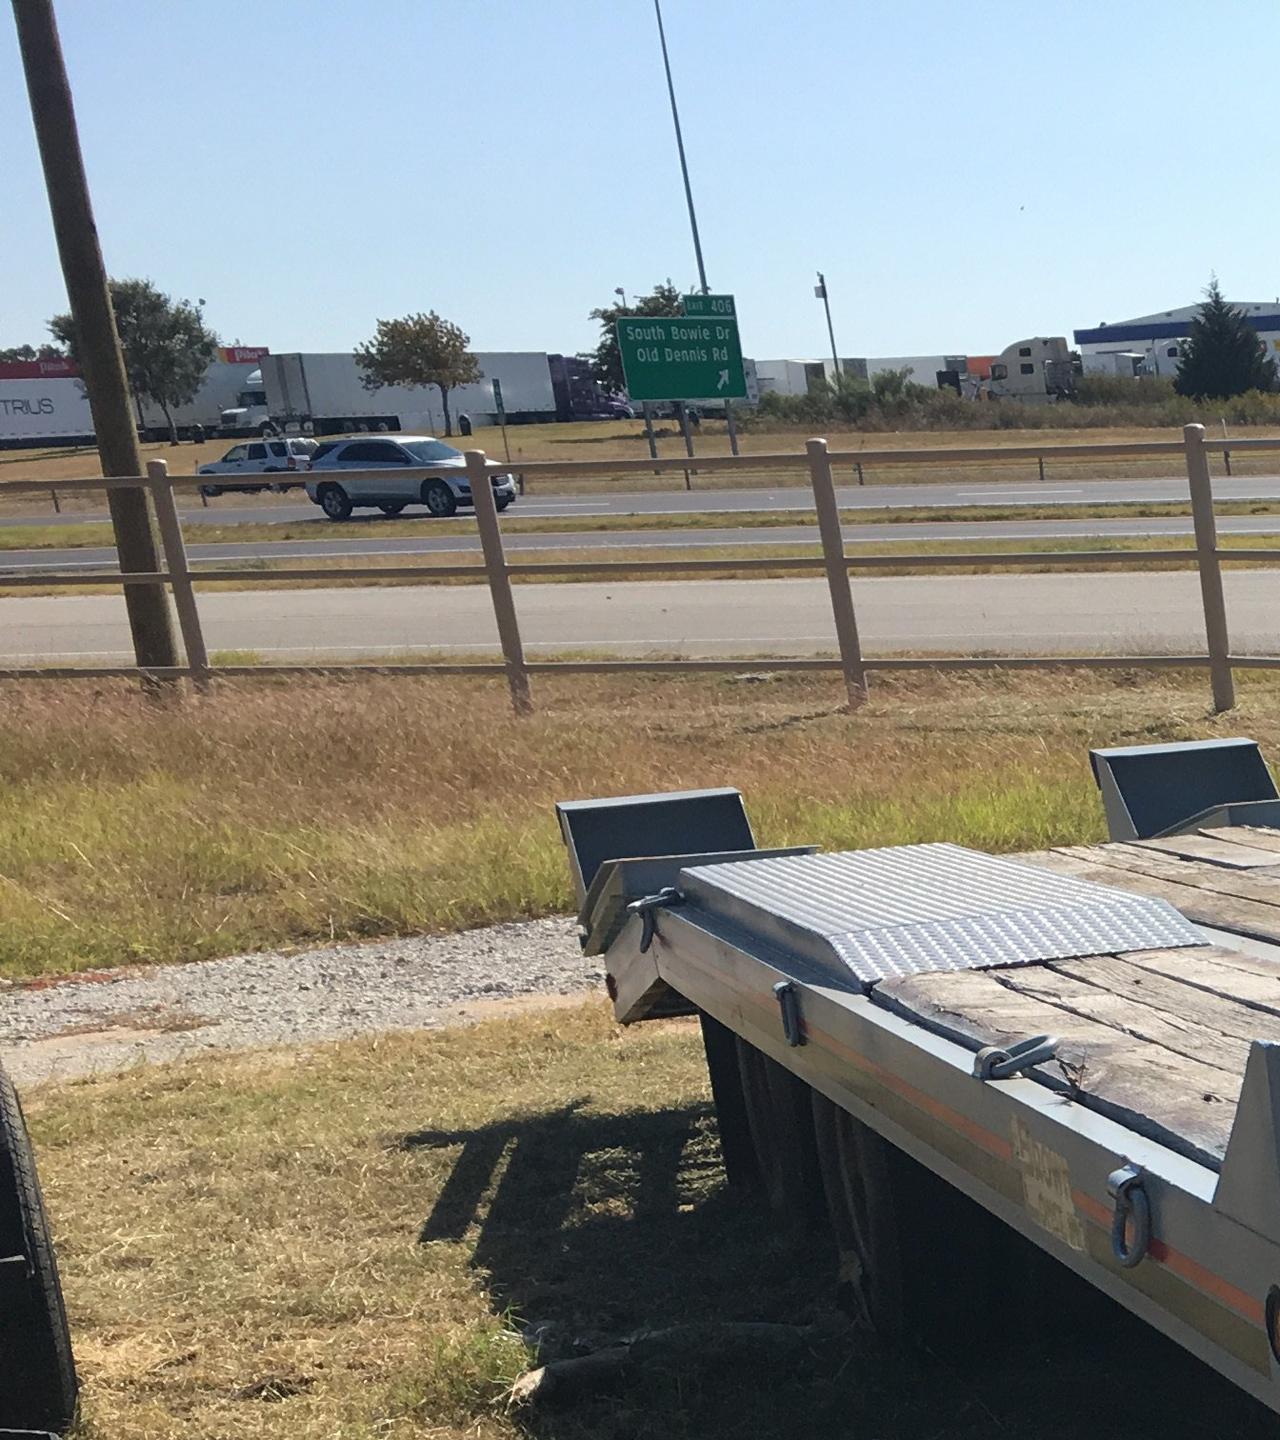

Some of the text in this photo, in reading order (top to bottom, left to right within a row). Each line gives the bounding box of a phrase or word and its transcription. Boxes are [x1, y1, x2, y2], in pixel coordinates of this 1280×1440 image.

[711, 299, 732, 313] 406
[626, 325, 730, 340] South Bowie Dr
[637, 346, 729, 361] Old Dennis Rd
[0, 398, 55, 416] TRIUS
